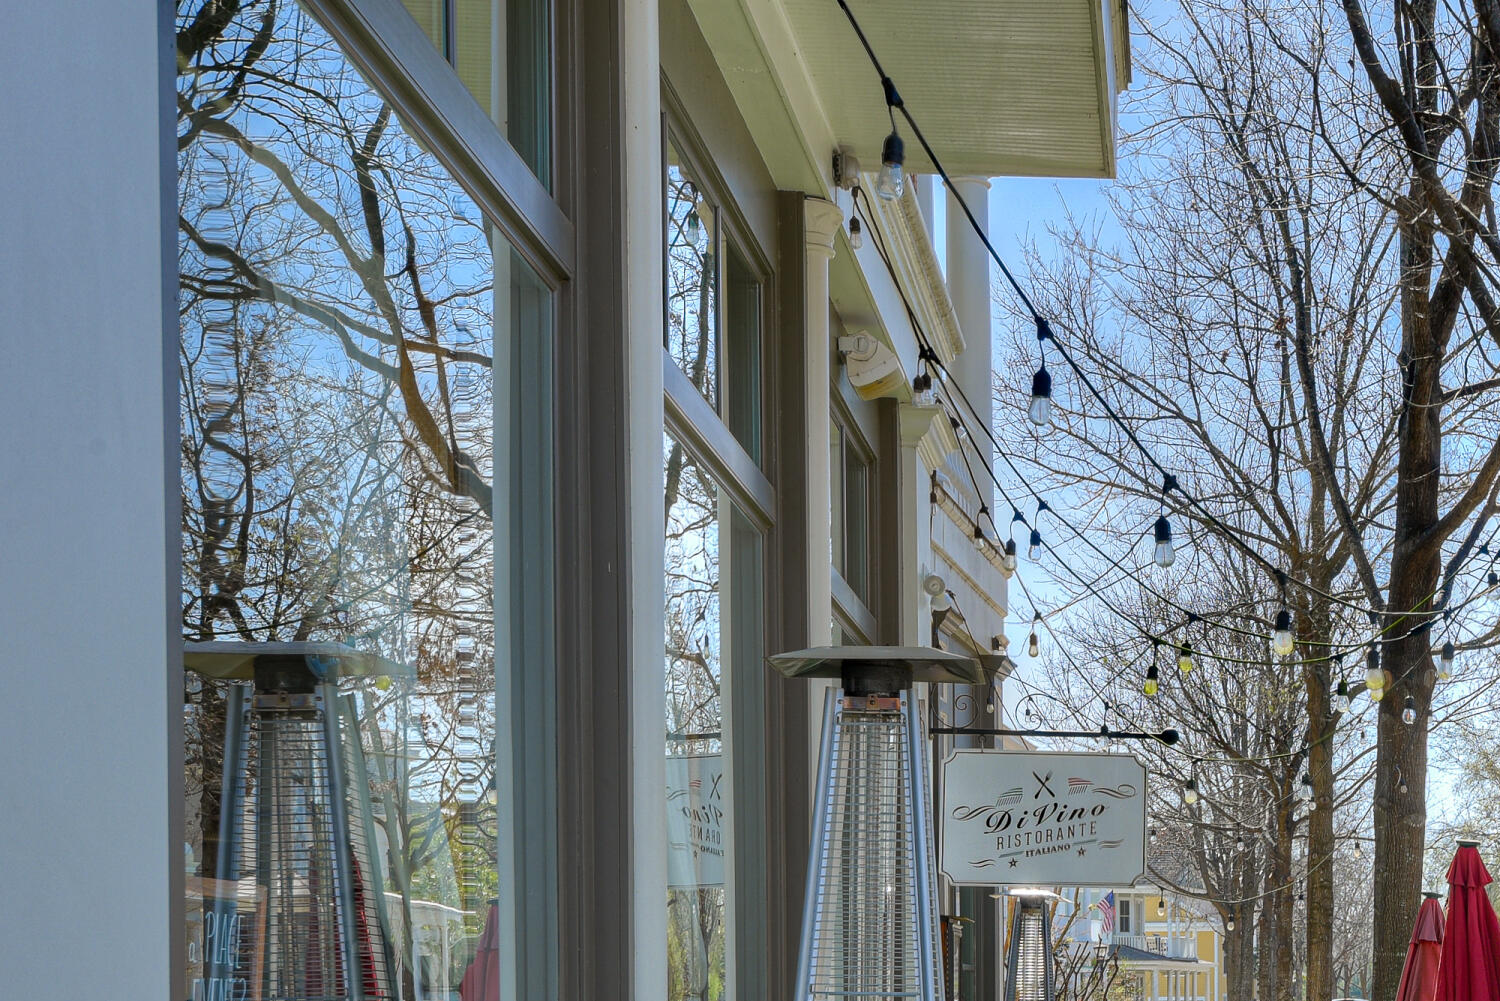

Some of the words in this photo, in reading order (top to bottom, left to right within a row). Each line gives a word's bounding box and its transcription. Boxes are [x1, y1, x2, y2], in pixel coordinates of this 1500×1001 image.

[996, 821, 1097, 850] RISTORANTE
[1025, 843, 1071, 857] ITALIANO
[205, 911, 246, 969] PLACE
